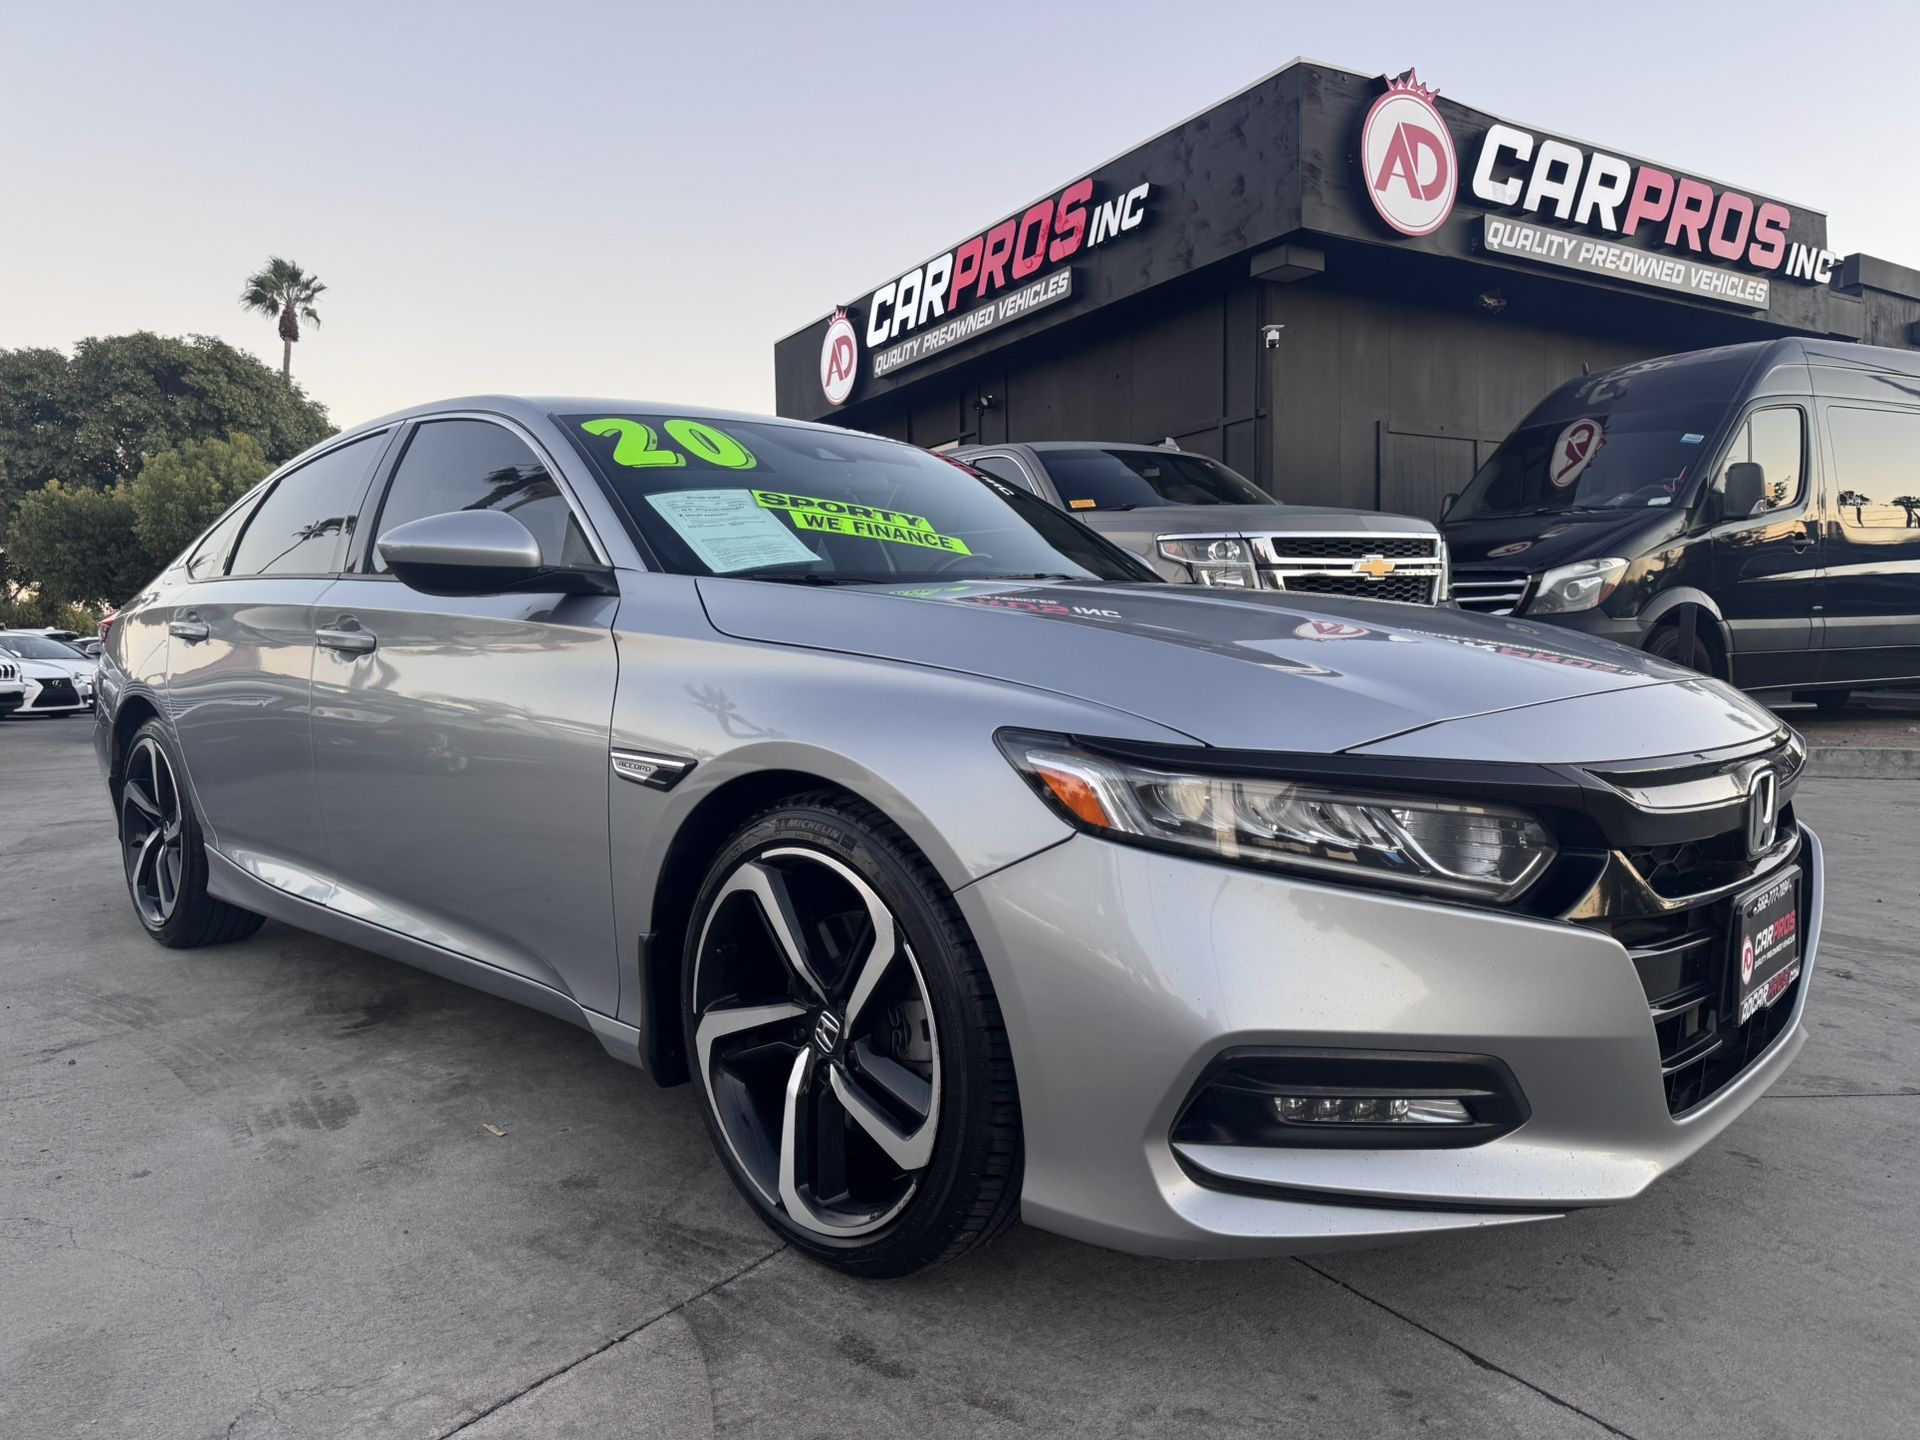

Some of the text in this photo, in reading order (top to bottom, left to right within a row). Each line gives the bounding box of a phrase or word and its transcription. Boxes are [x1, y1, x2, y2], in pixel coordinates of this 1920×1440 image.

[1472, 124, 1836, 284] CARPROS INC
[866, 178, 1149, 348] CARPROS INC
[1487, 221, 1768, 303] QUALITY PRE-OWNED VEHICLES
[874, 270, 1070, 376] QUALITY PRE-OWNED VEHICLES
[580, 418, 757, 470] 20
[759, 491, 927, 529] SPORTY
[802, 514, 955, 550] WE FINANCE
[618, 761, 652, 773] ACCORD
[787, 818, 841, 840] MICHELIN
